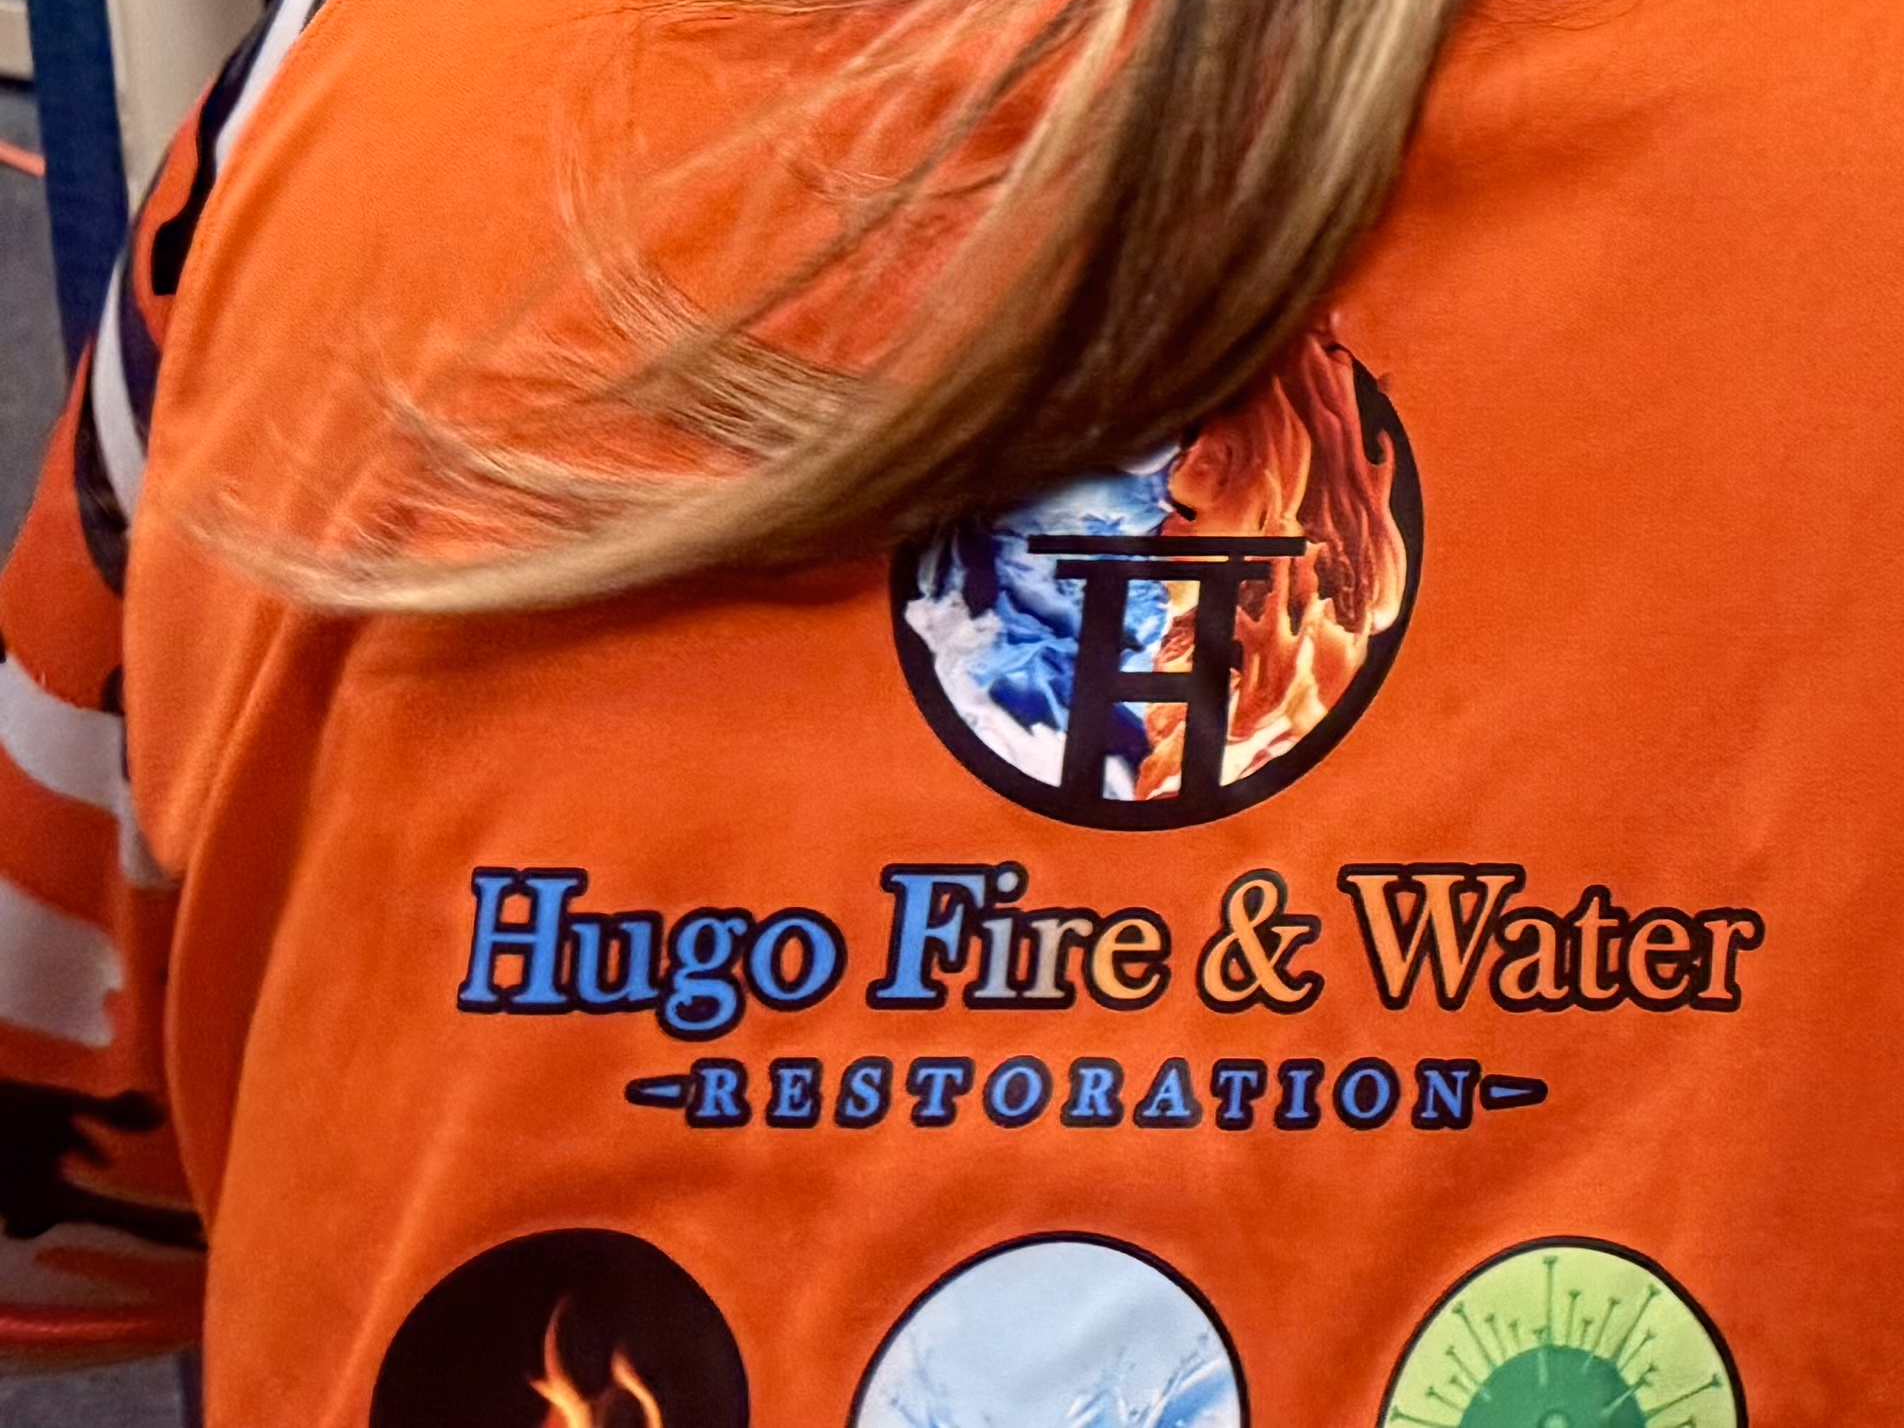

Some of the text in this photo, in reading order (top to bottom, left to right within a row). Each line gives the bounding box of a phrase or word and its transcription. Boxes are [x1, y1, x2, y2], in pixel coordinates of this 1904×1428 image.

[459, 861, 1766, 1042] Hugo Fire & Water
